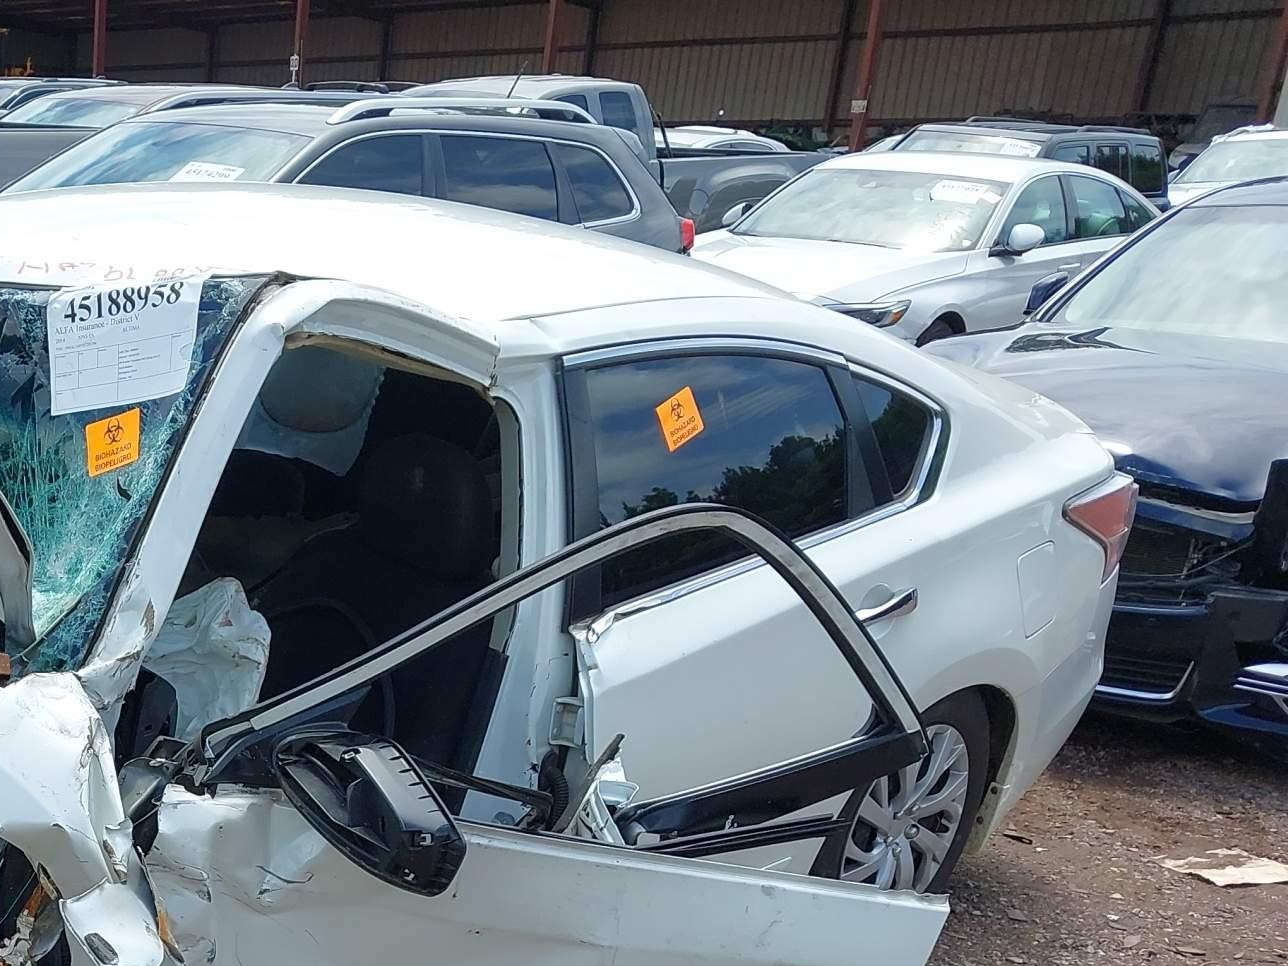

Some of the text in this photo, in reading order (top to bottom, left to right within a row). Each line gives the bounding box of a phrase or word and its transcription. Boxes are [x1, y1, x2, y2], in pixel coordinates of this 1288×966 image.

[64, 281, 184, 323] 45188958
[55, 326, 74, 335] ALFA
[76, 321, 105, 332] Insurance
[110, 315, 133, 326] District
[94, 452, 132, 472] BIOPELIGRO
[95, 442, 132, 462] BIOHAZARD
